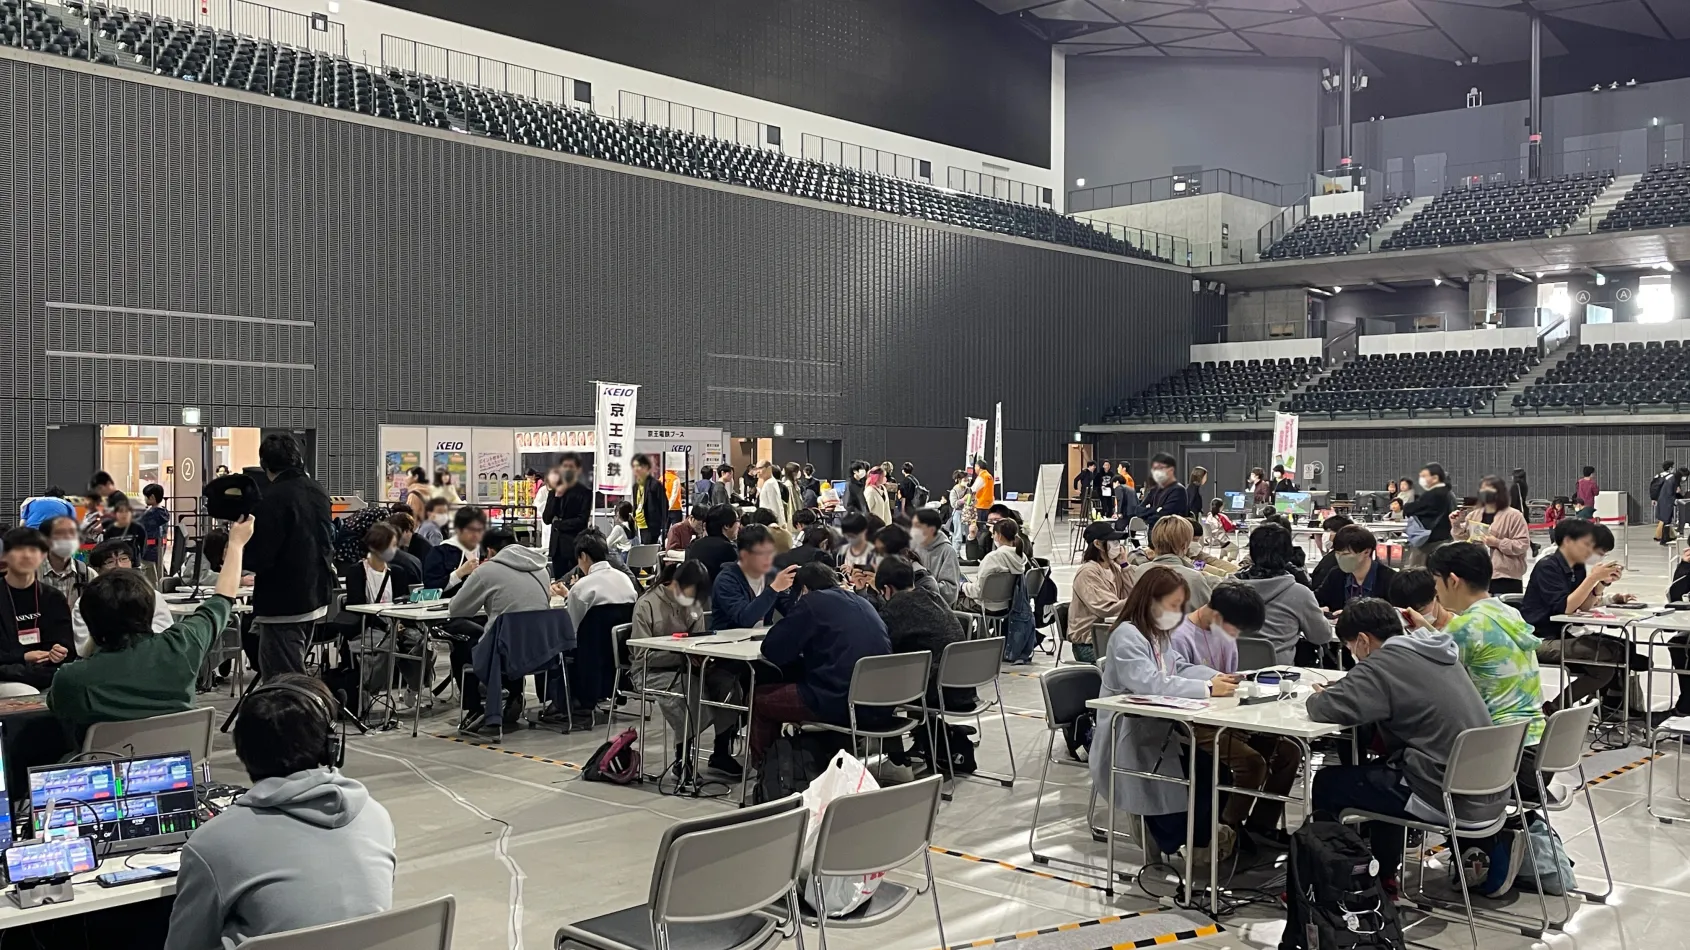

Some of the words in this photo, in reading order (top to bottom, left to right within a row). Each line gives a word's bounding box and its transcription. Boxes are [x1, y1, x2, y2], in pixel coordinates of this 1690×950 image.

[604, 388, 634, 397] KEIO
[607, 403, 625, 477] 京王電鉄
[436, 441, 464, 450] KEIO
[671, 444, 692, 453] KEIO
